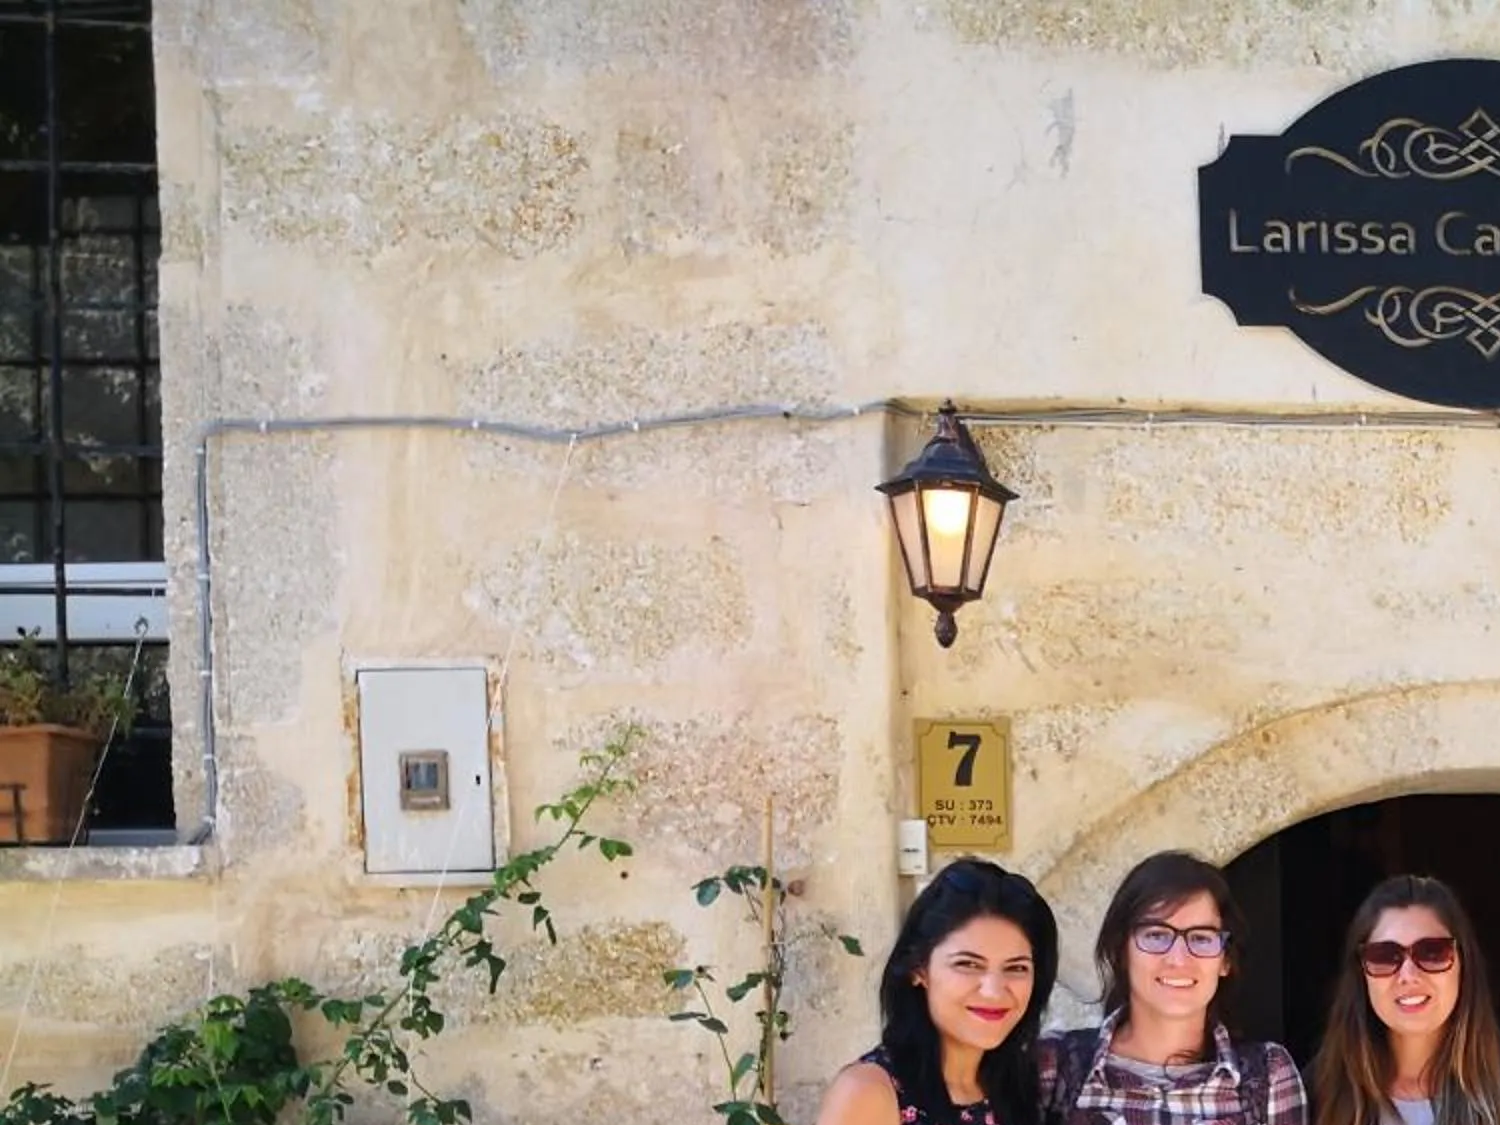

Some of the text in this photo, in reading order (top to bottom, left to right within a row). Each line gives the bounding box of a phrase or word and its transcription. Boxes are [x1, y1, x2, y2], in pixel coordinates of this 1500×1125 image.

[1228, 207, 1417, 256] Larissa
[947, 731, 982, 787] 7
[934, 800, 956, 811] SU
